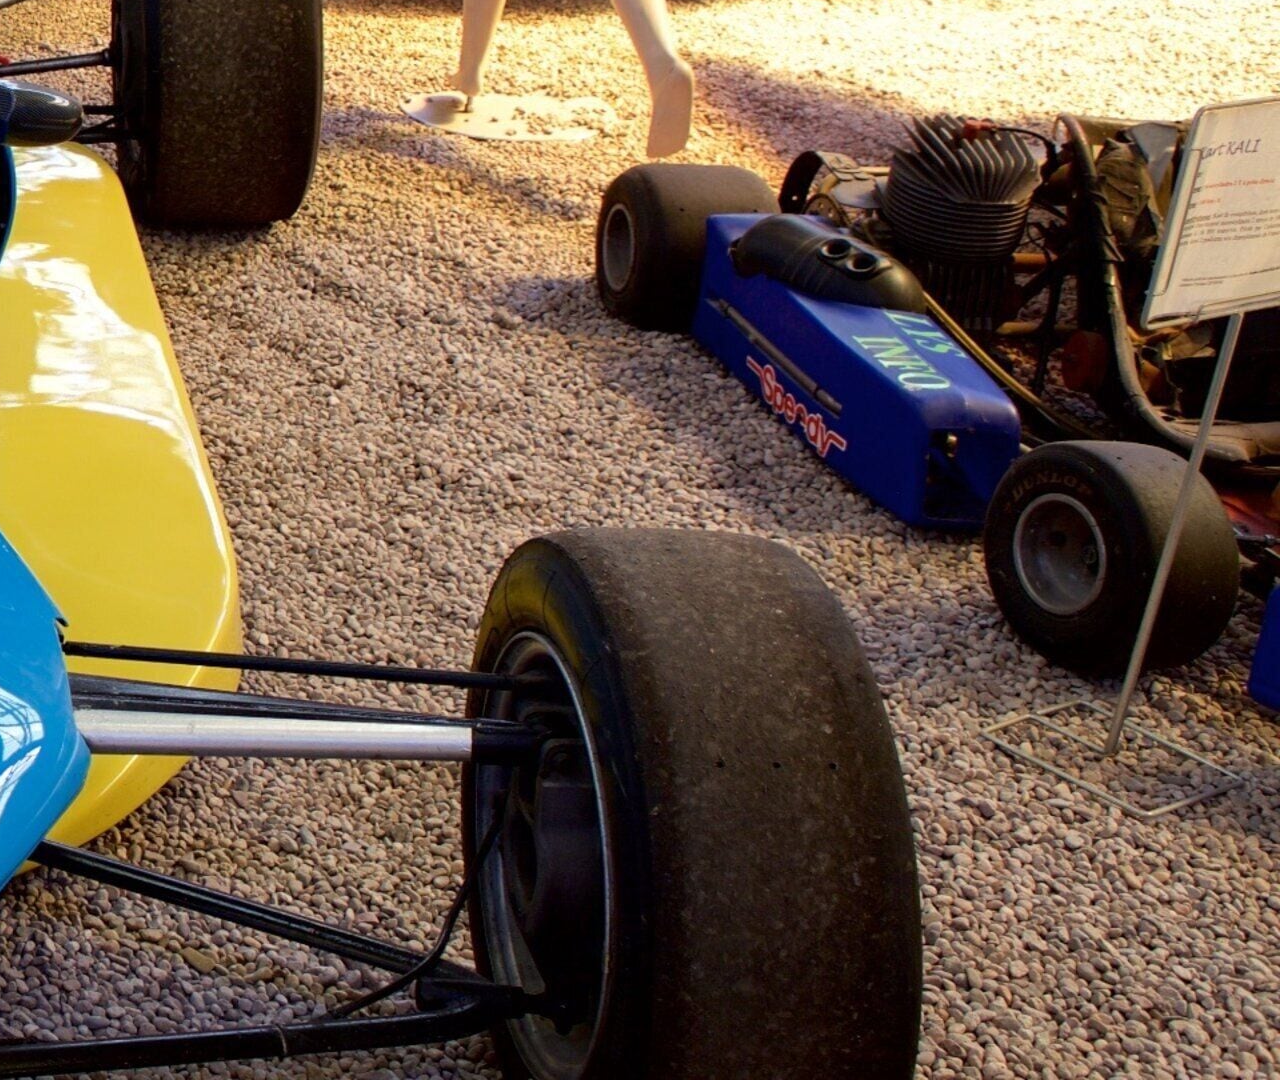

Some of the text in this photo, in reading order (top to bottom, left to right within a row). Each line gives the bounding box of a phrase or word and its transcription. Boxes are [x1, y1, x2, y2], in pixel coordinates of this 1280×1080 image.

[1226, 138, 1262, 156] KALI
[851, 335, 952, 391] INFO
[746, 355, 848, 458] Speedy
